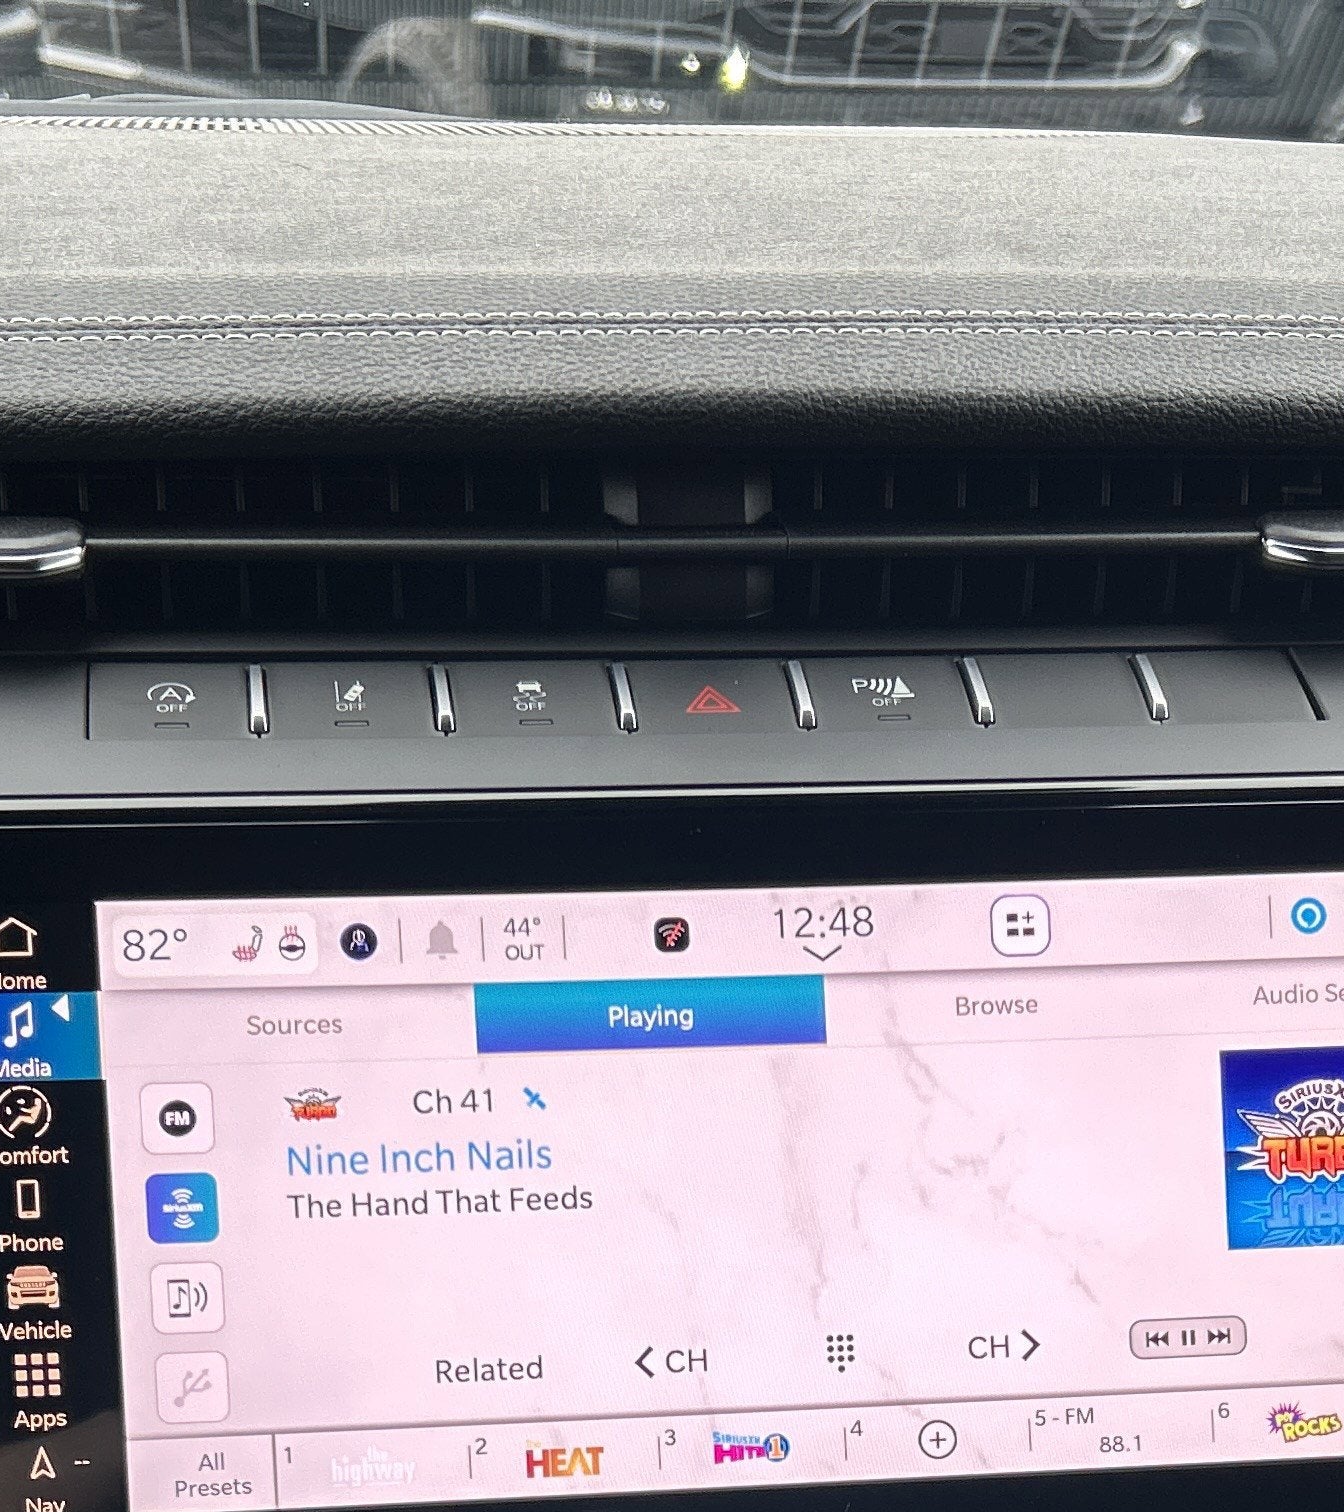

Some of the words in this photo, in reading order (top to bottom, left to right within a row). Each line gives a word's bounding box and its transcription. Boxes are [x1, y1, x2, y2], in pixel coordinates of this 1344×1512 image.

[157, 704, 187, 714] OFF
[336, 702, 367, 712] OFF
[503, 916, 540, 938] 44°
[774, 906, 875, 939] 12:48
[122, 929, 188, 963] 82°
[504, 943, 544, 962] OUT
[1253, 982, 1319, 1007] Audio
[955, 994, 1039, 1018] Browse
[246, 1013, 343, 1038] Sources
[608, 1004, 695, 1031] Playing
[413, 1089, 454, 1114] Ch
[460, 1089, 494, 1113] 41
[165, 1111, 190, 1126] FM
[287, 1145, 369, 1176] Nine
[381, 1142, 456, 1173] Inch
[467, 1138, 553, 1171] Nails
[287, 1193, 343, 1219] The
[351, 1190, 429, 1217] Hand
[435, 1188, 502, 1215] That
[510, 1185, 594, 1211] Feeds
[968, 1335, 1010, 1360] CH
[436, 1355, 544, 1384] Related
[665, 1348, 709, 1374] CH
[14, 1410, 67, 1431] Apps
[1035, 1410, 1046, 1426] 5
[1065, 1408, 1094, 1424] FM
[1218, 1402, 1230, 1419] 6
[665, 1429, 676, 1446] 3
[850, 1420, 864, 1436] 4
[1282, 1414, 1342, 1442] ROCKS
[475, 1438, 487, 1455] 2
[1100, 1435, 1142, 1453] 88.1
[198, 1452, 225, 1471] All
[284, 1447, 292, 1464] 1
[526, 1446, 604, 1478] HEAT
[175, 1478, 253, 1498] Presets
